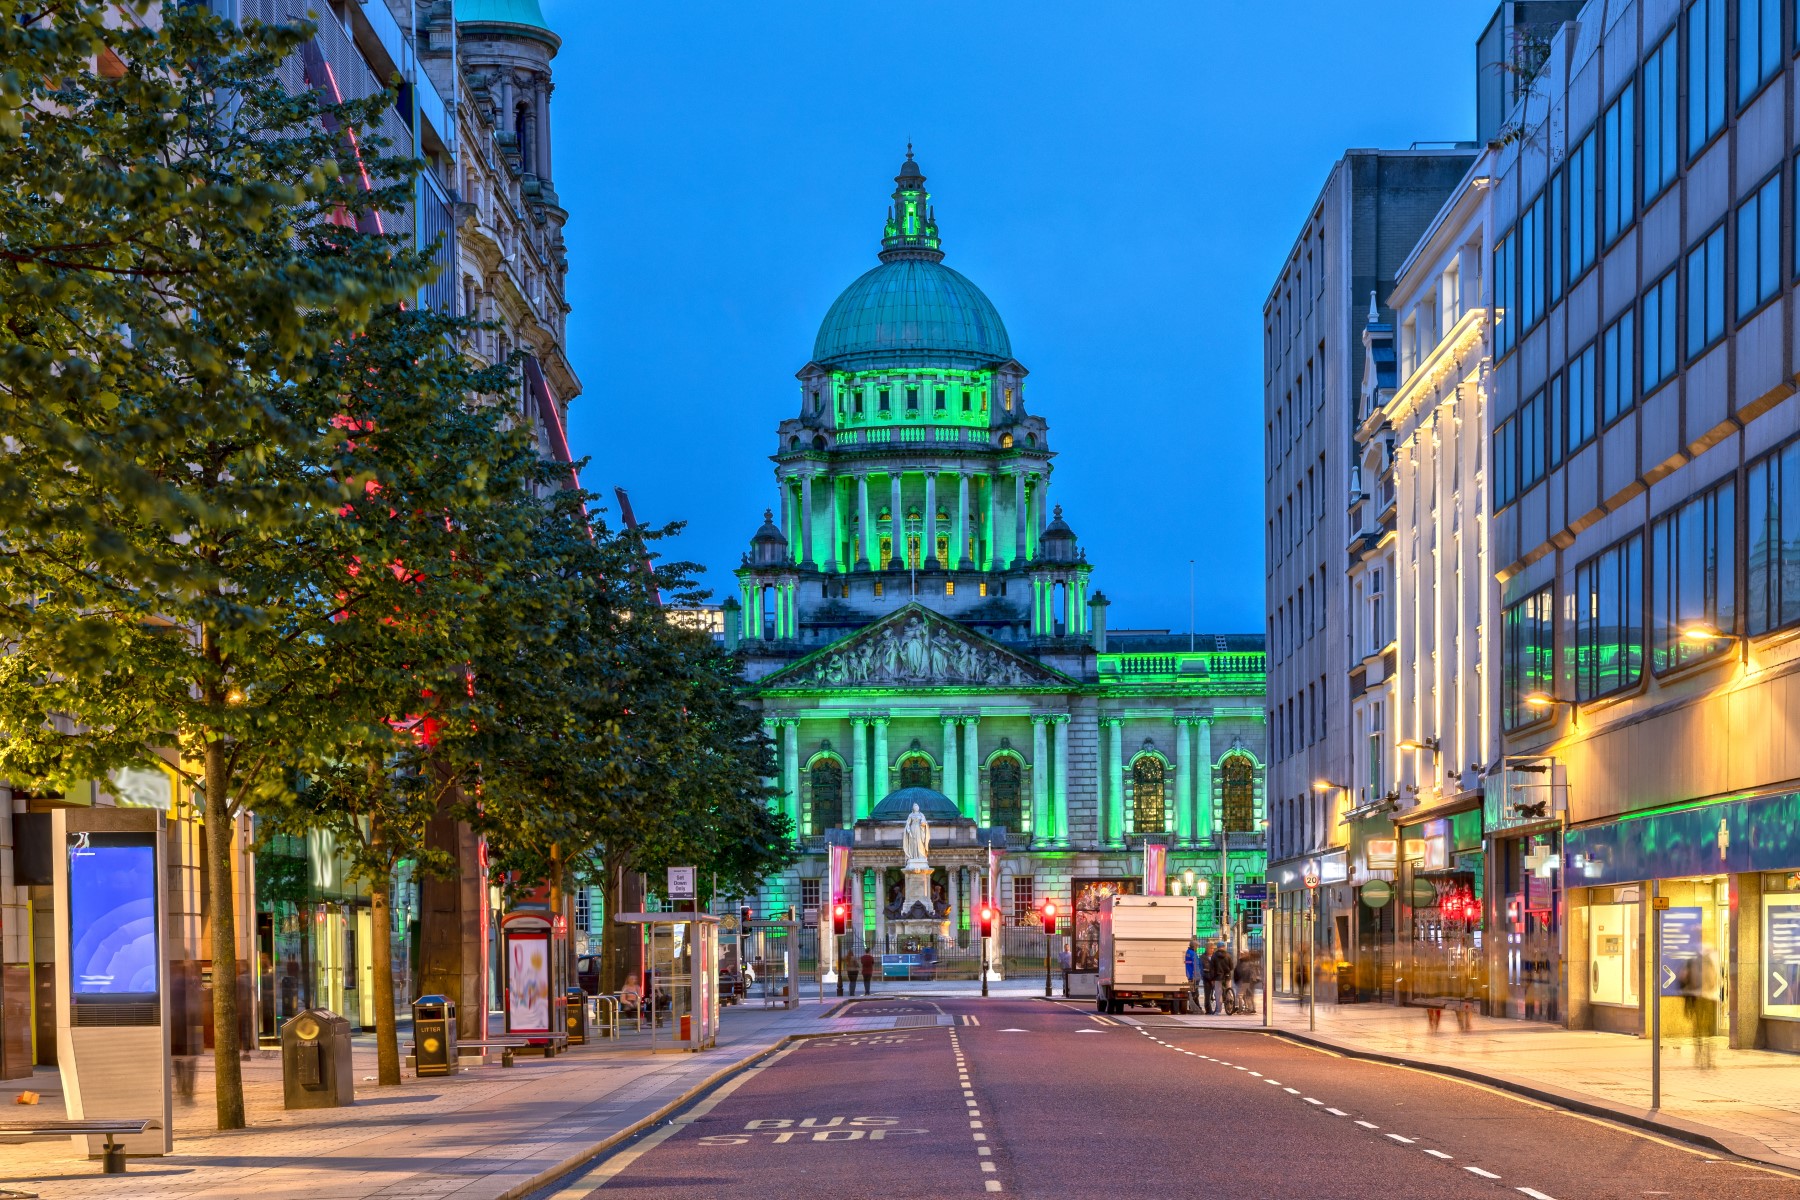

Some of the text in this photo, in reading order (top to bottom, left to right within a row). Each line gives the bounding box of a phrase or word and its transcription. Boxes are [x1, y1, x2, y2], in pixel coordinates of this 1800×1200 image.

[1306, 876, 1317, 884] 20
[743, 1115, 900, 1130] BUS
[697, 1128, 931, 1146] STOP
